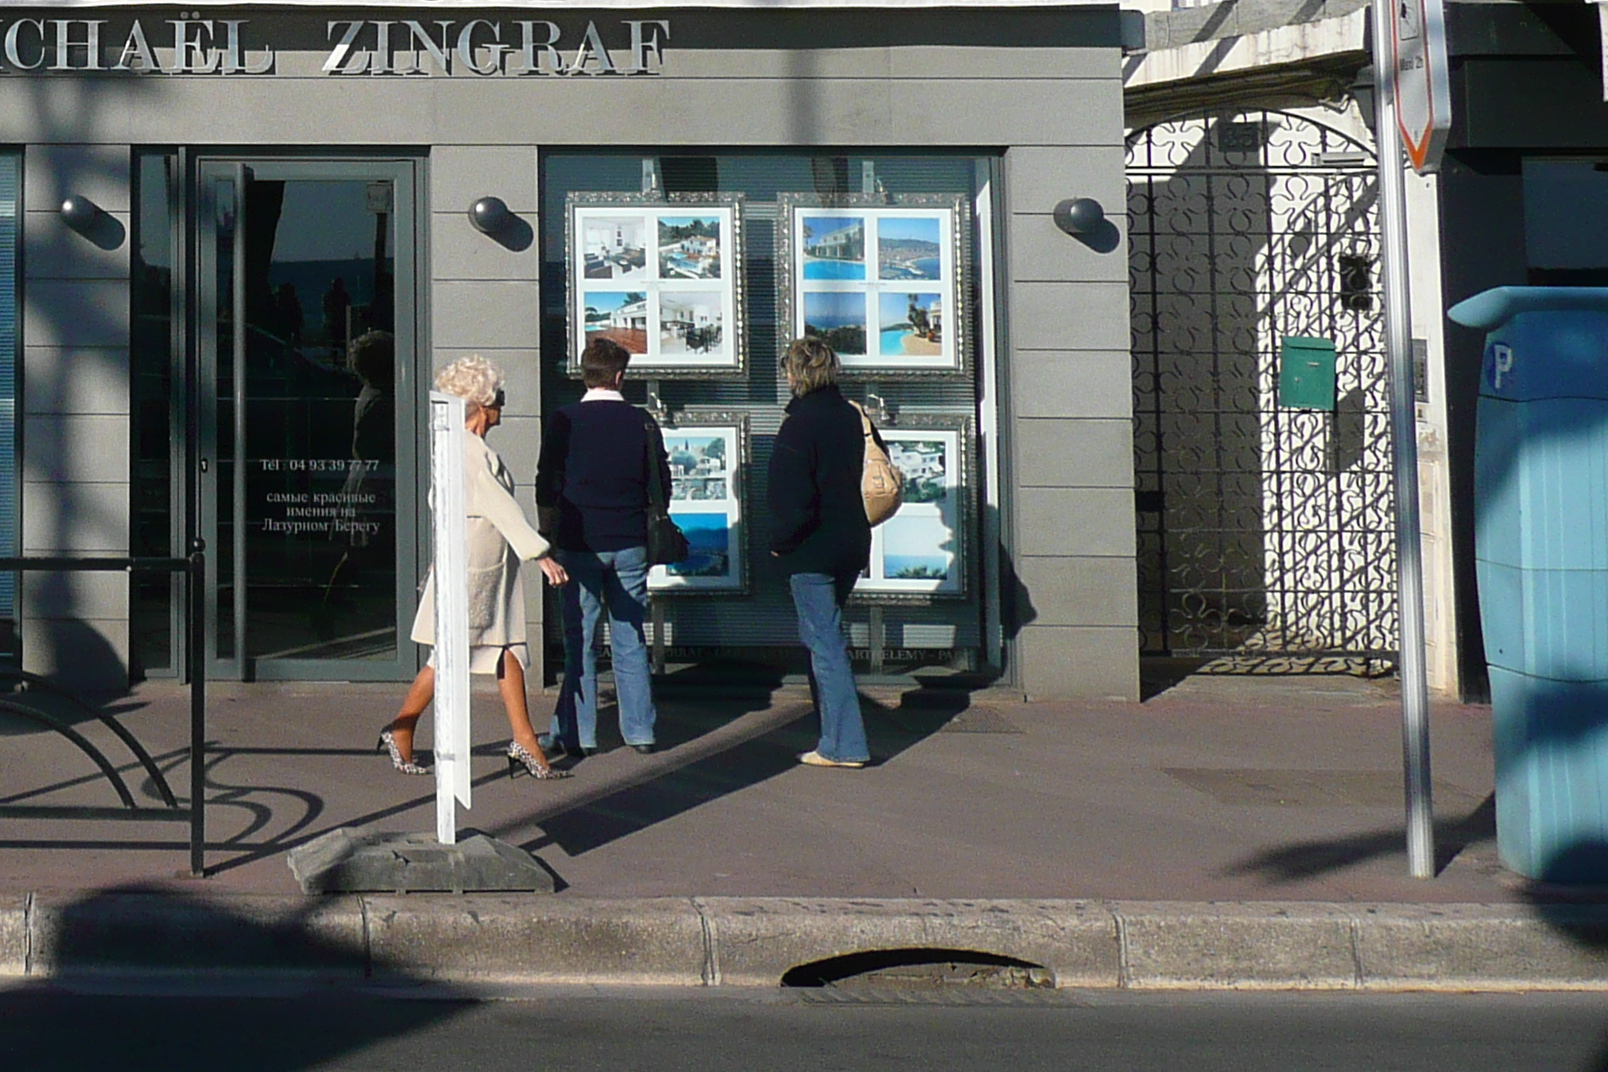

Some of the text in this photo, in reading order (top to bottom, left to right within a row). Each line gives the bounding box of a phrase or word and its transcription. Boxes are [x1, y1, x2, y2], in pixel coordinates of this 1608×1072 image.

[320, 19, 671, 77] ZINGRAF
[1493, 343, 1513, 388] P
[259, 458, 280, 471] Tél
[289, 459, 306, 471] 04
[309, 459, 326, 471] 93
[328, 459, 345, 471] 39
[348, 459, 363, 471] 77
[364, 459, 380, 471] 77
[266, 492, 377, 506] самые красивые
[286, 507, 357, 518] имения на
[262, 518, 381, 536] Лазурном Берегу
